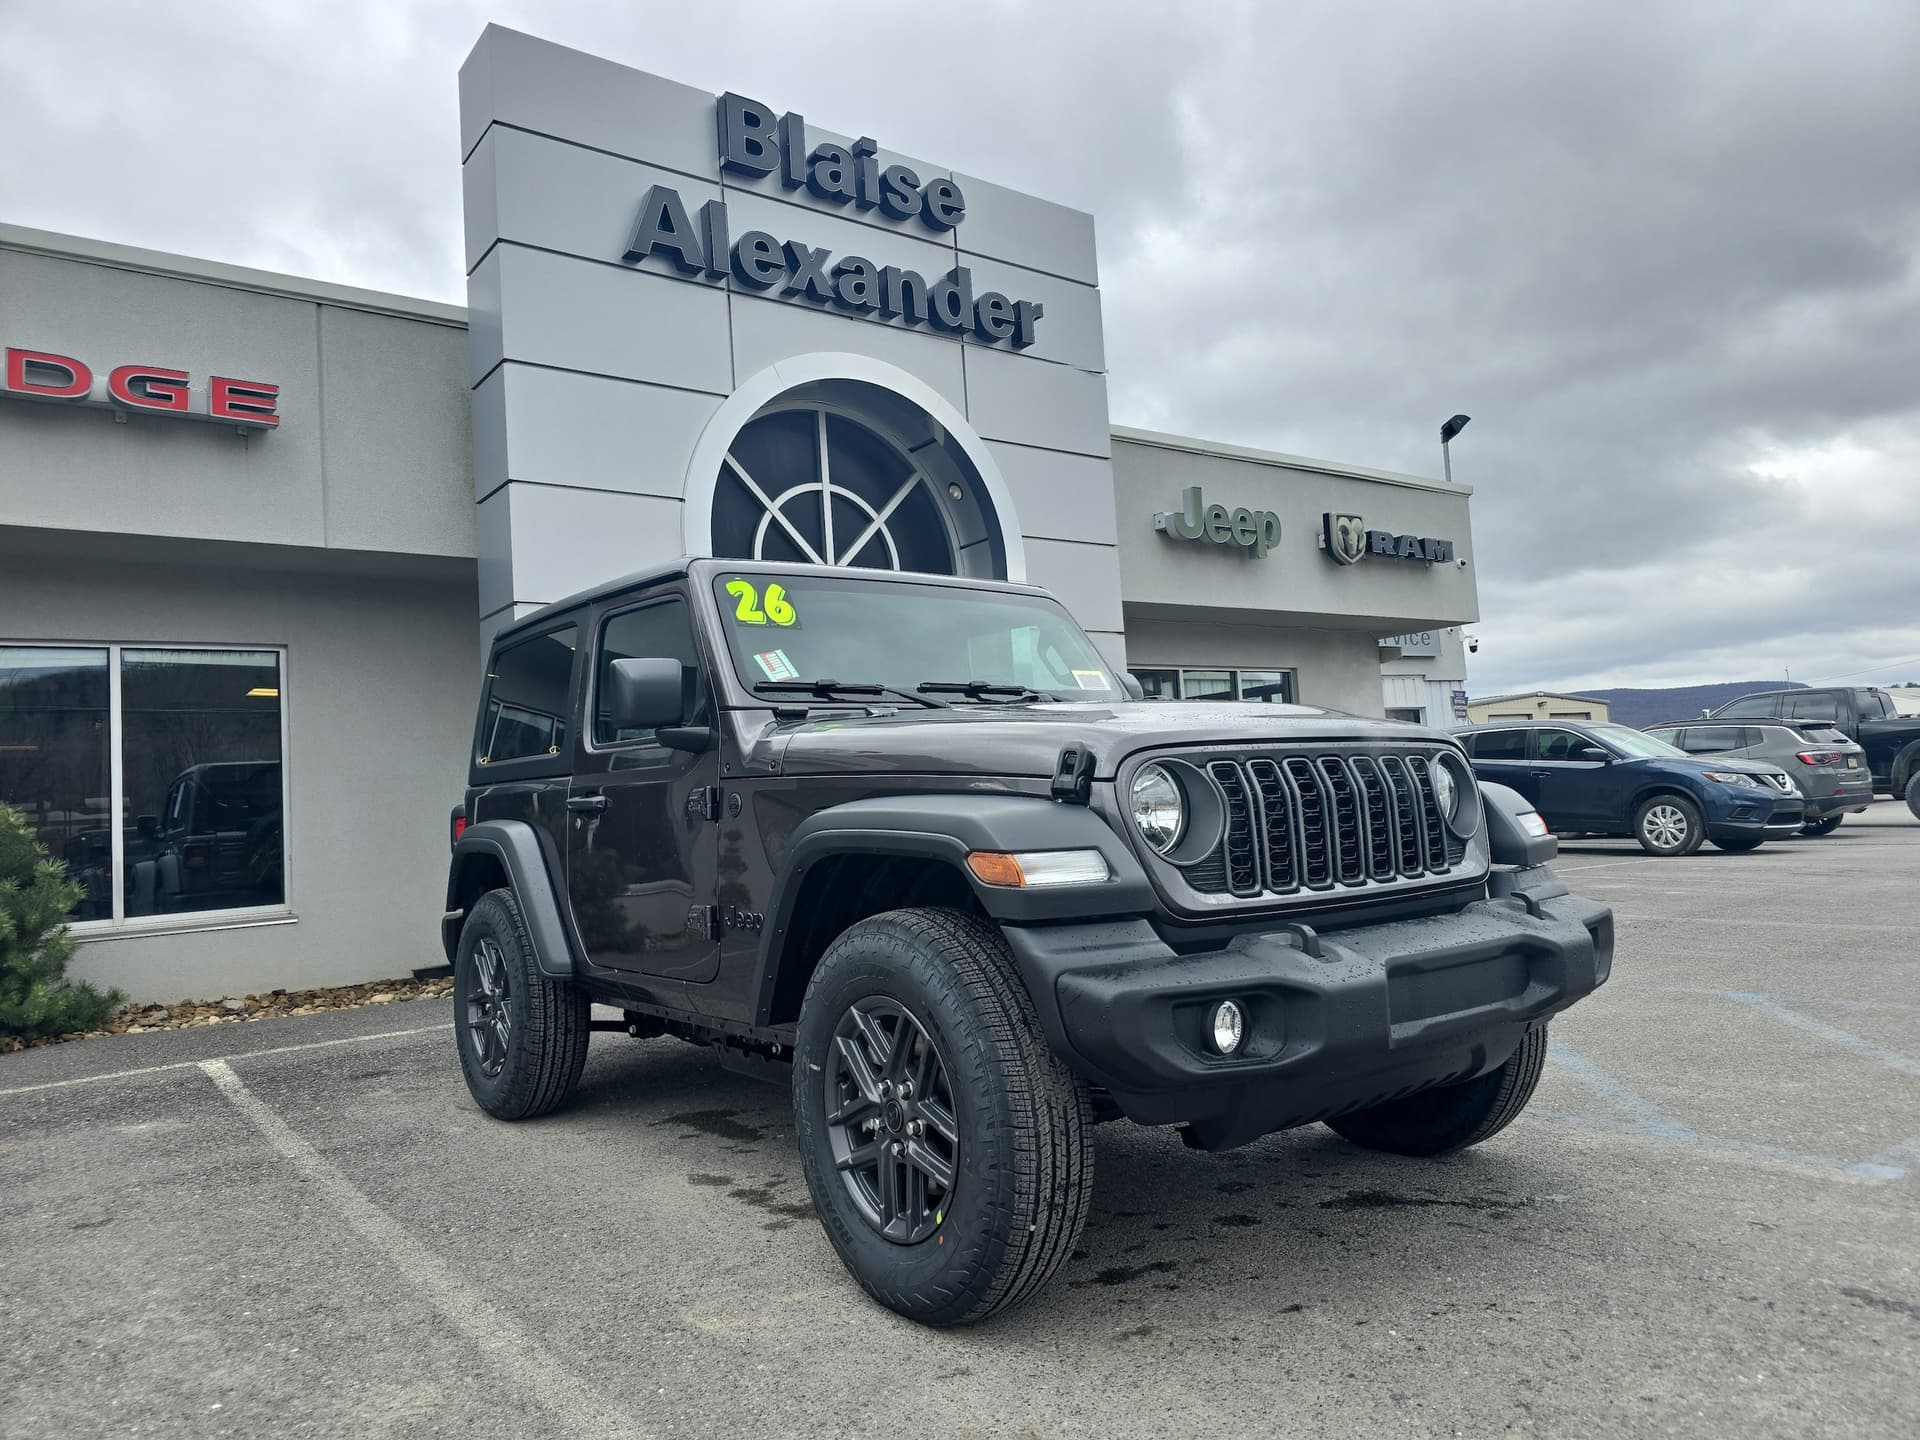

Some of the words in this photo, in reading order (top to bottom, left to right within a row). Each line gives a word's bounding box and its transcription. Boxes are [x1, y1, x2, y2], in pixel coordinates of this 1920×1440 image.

[718, 91, 966, 232] Blaise
[622, 184, 1044, 349] Alexander
[5, 346, 280, 428] DGE
[1166, 486, 1282, 560] Jeep
[1366, 529, 1454, 563] RAM
[725, 579, 797, 626] 26
[724, 904, 765, 936] Jeep
